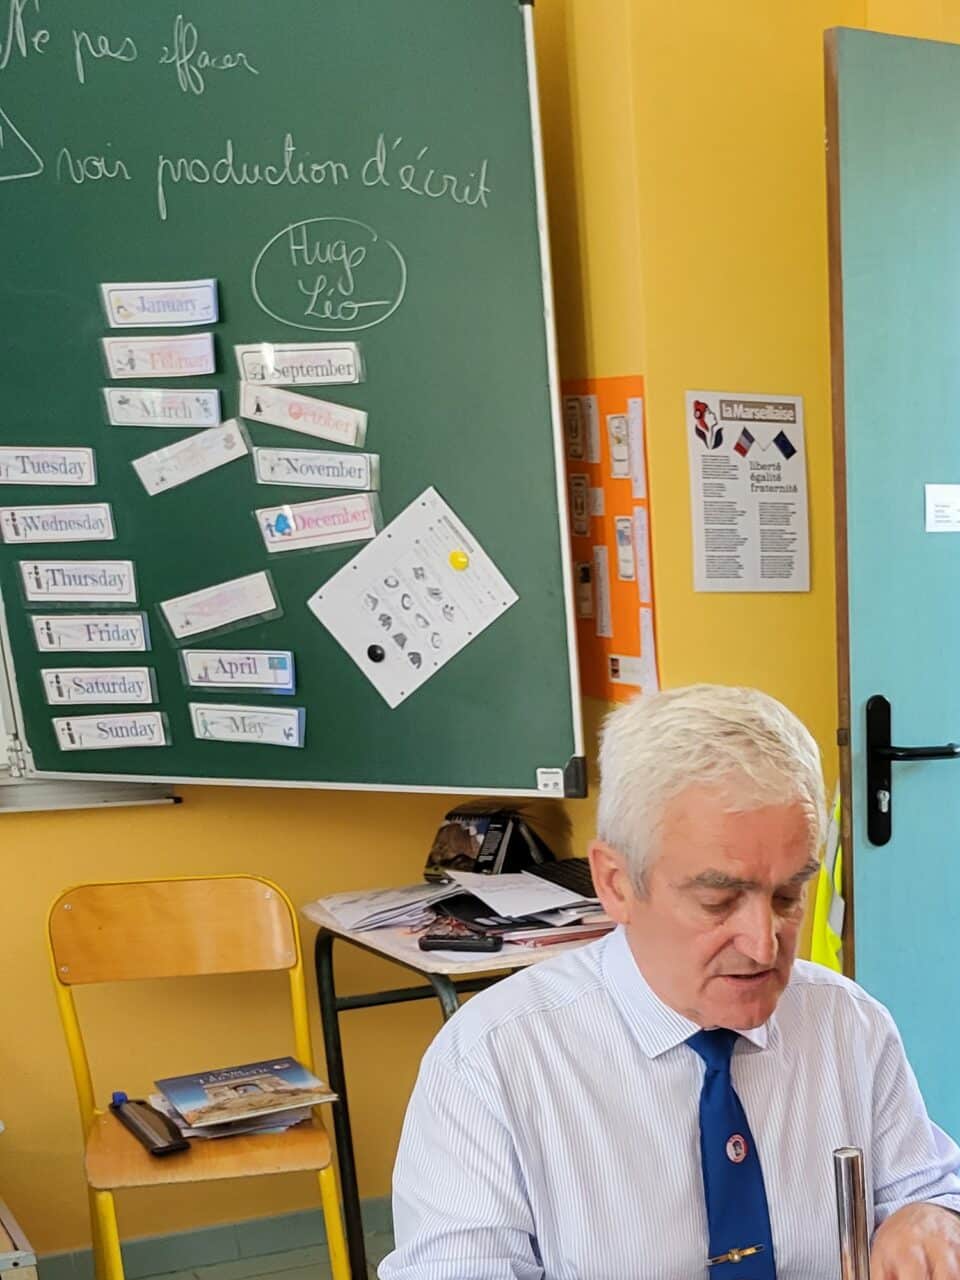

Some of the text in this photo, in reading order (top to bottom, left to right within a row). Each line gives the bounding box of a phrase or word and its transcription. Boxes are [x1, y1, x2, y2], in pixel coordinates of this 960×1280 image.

[72, 29, 138, 84] pas
[159, 14, 259, 95] effacer
[57, 133, 491, 220] voir production d'écrit
[288, 223, 366, 296] Hugo
[136, 295, 199, 313] January
[298, 274, 391, 320] Léo
[270, 359, 353, 382] September
[15, 455, 87, 480] Tuesday
[278, 457, 365, 479] November
[749, 461, 782, 472] liberté
[749, 473, 782, 484] égalité
[750, 484, 799, 494] fraternité
[21, 514, 105, 534] Wednesday
[293, 508, 367, 531] December
[45, 568, 125, 591] Thursday
[84, 623, 138, 645] Friday
[215, 657, 259, 679] April
[72, 676, 144, 698] Saturday
[96, 721, 156, 740] Sunday
[227, 716, 264, 738] May
